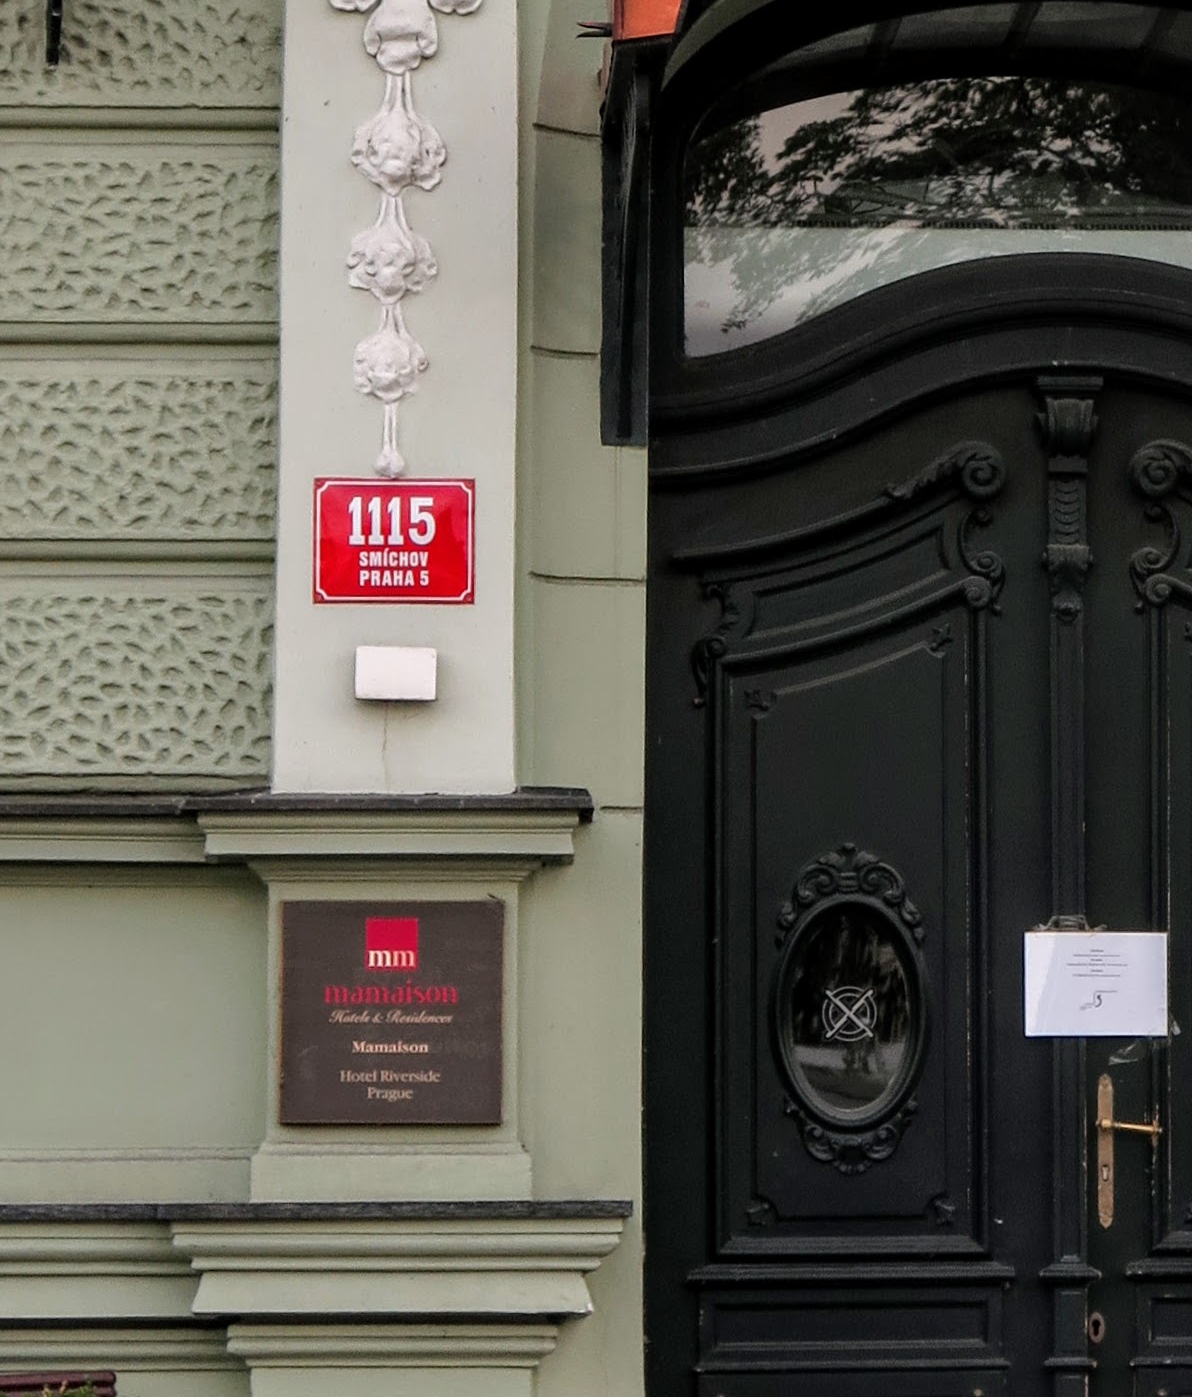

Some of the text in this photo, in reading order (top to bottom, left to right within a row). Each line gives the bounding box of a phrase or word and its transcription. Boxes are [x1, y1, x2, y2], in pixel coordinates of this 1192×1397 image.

[348, 496, 436, 546] 1115
[359, 547, 429, 568] SMÍCHOV
[359, 570, 430, 587] PRAHA 5
[368, 949, 416, 968] mm
[324, 979, 458, 1005] mamaison
[329, 1009, 453, 1024] Hotels & Residences
[351, 1040, 429, 1054] Mamaison
[340, 1069, 441, 1083] Hotel Riverside
[366, 1086, 414, 1102] Prague
